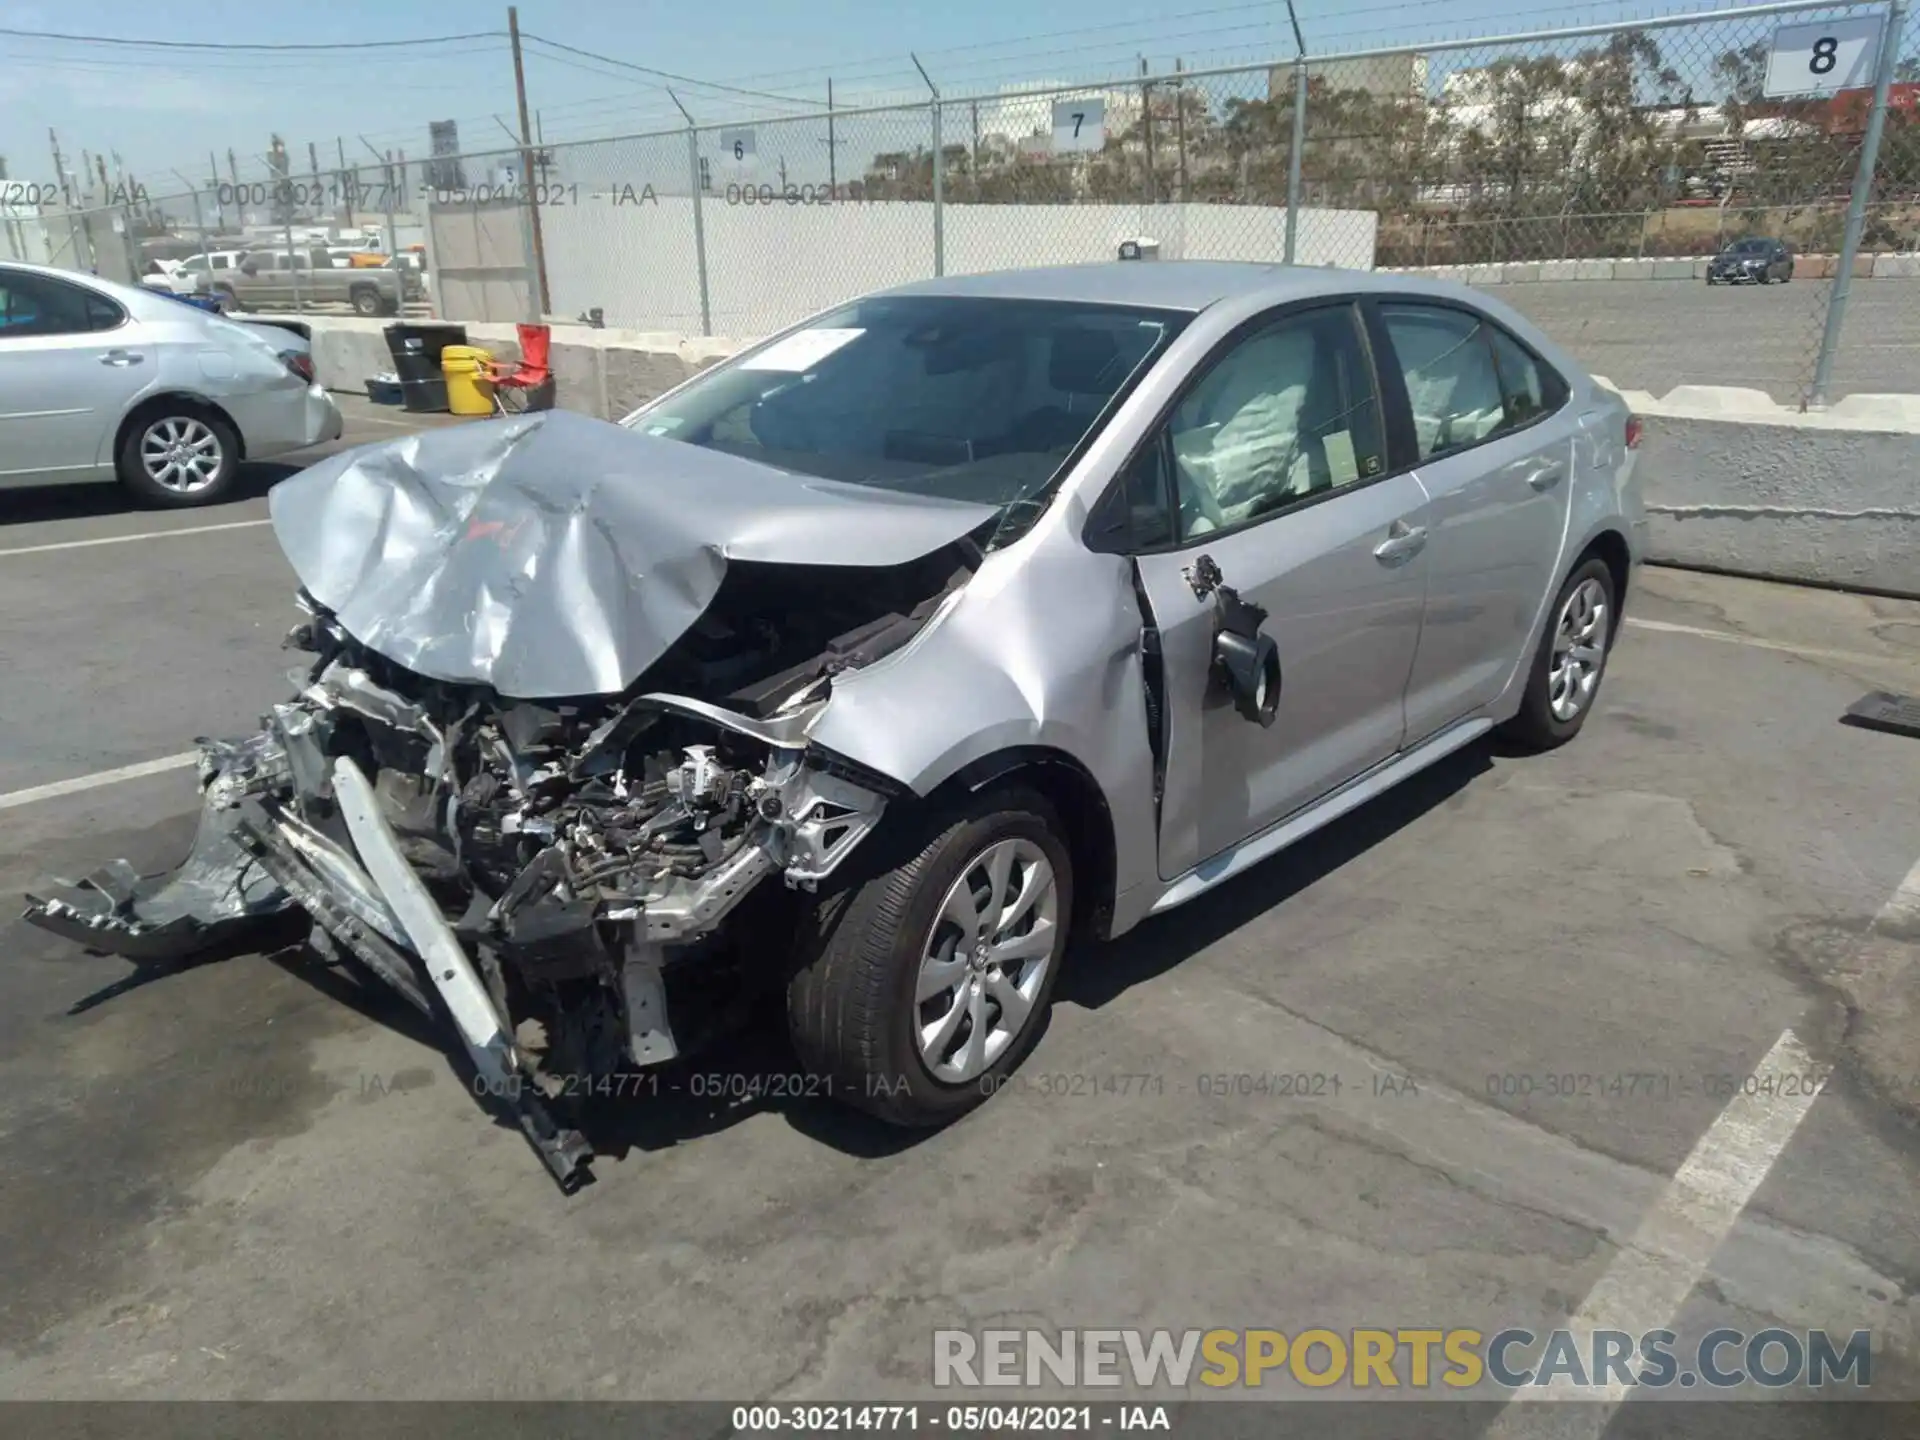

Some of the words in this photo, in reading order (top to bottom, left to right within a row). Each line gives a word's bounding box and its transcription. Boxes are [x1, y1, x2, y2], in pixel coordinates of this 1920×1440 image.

[1809, 37, 1838, 74] 8
[1071, 113, 1084, 138] 7
[734, 139, 744, 160] 6
[506, 166, 514, 183] 5
